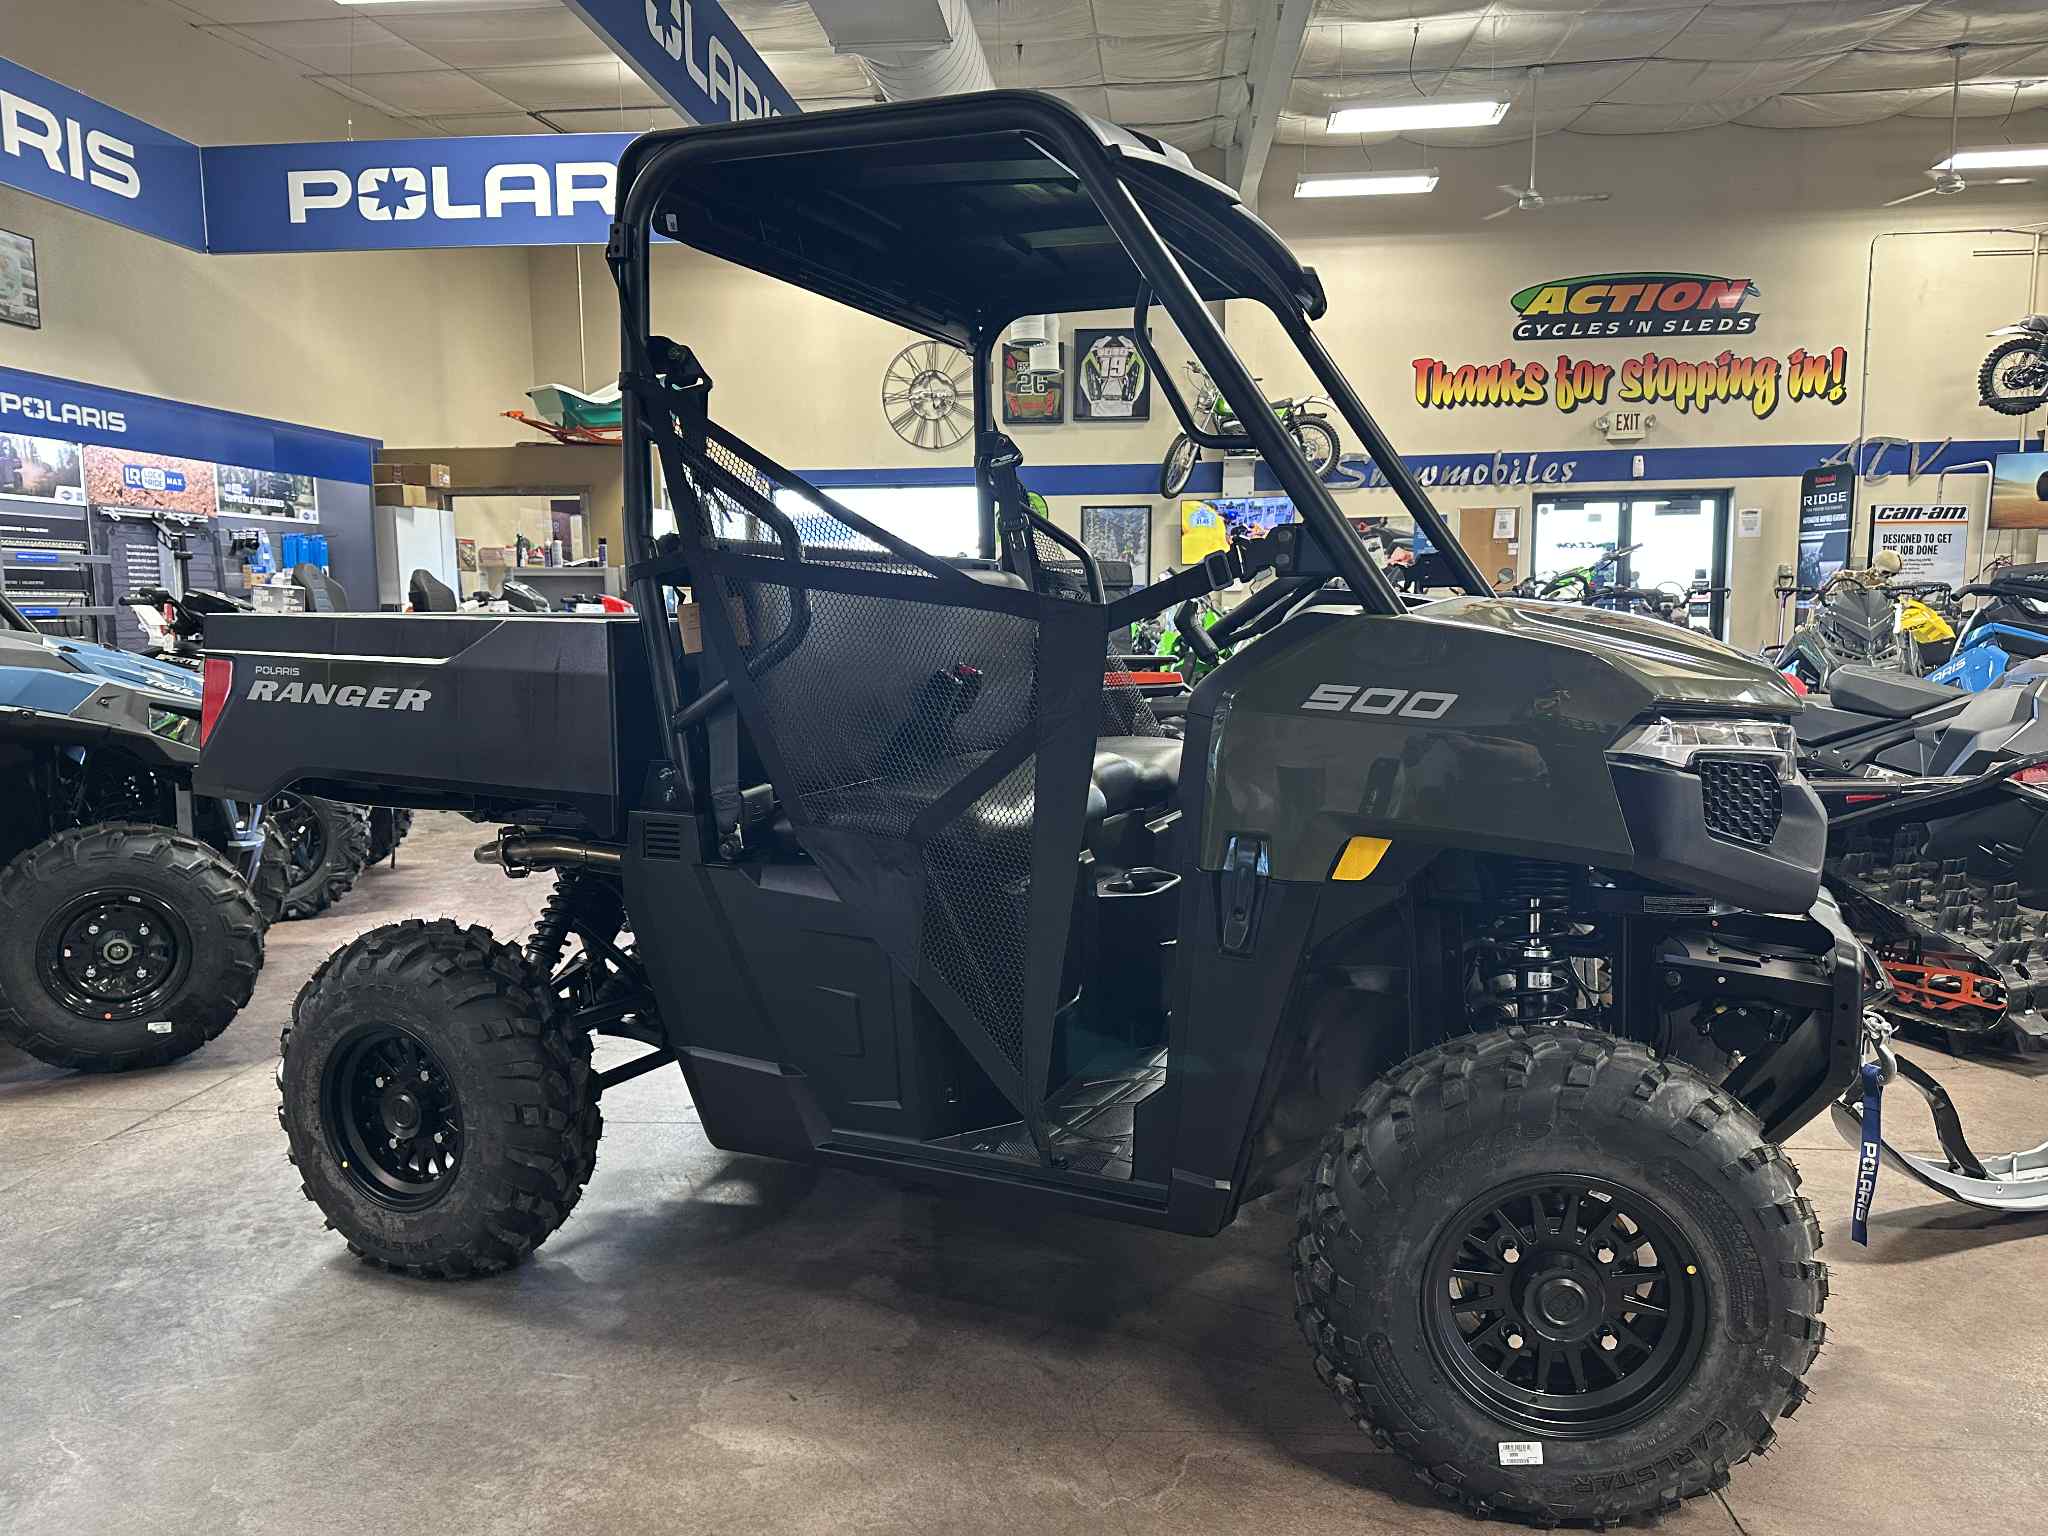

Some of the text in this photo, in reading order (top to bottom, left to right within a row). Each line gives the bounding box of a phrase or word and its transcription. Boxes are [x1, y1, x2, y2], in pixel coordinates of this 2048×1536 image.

[1523, 279, 1750, 315] ACTION
[1517, 318, 1751, 338] CYCLES 'N SLEDS
[1016, 372, 1049, 396] 26
[1412, 346, 1848, 420] Thanks for stopping in!
[0, 391, 127, 433] POLARIS
[1615, 414, 1641, 431] EXIT
[1324, 450, 1577, 490] Snwmobiles
[166, 477, 184, 487] MAX
[1803, 491, 1847, 506] RIDGE
[1878, 506, 1967, 519] can-am
[1882, 533, 1953, 544] DESIGNED TO GET
[1900, 545, 1914, 555] JOB
[1916, 545, 1939, 555] DONE
[255, 666, 300, 676] POLARIS
[247, 679, 432, 712] RANGER
[1301, 683, 1459, 720] 500
[1856, 1141, 1877, 1222] POLARIS
